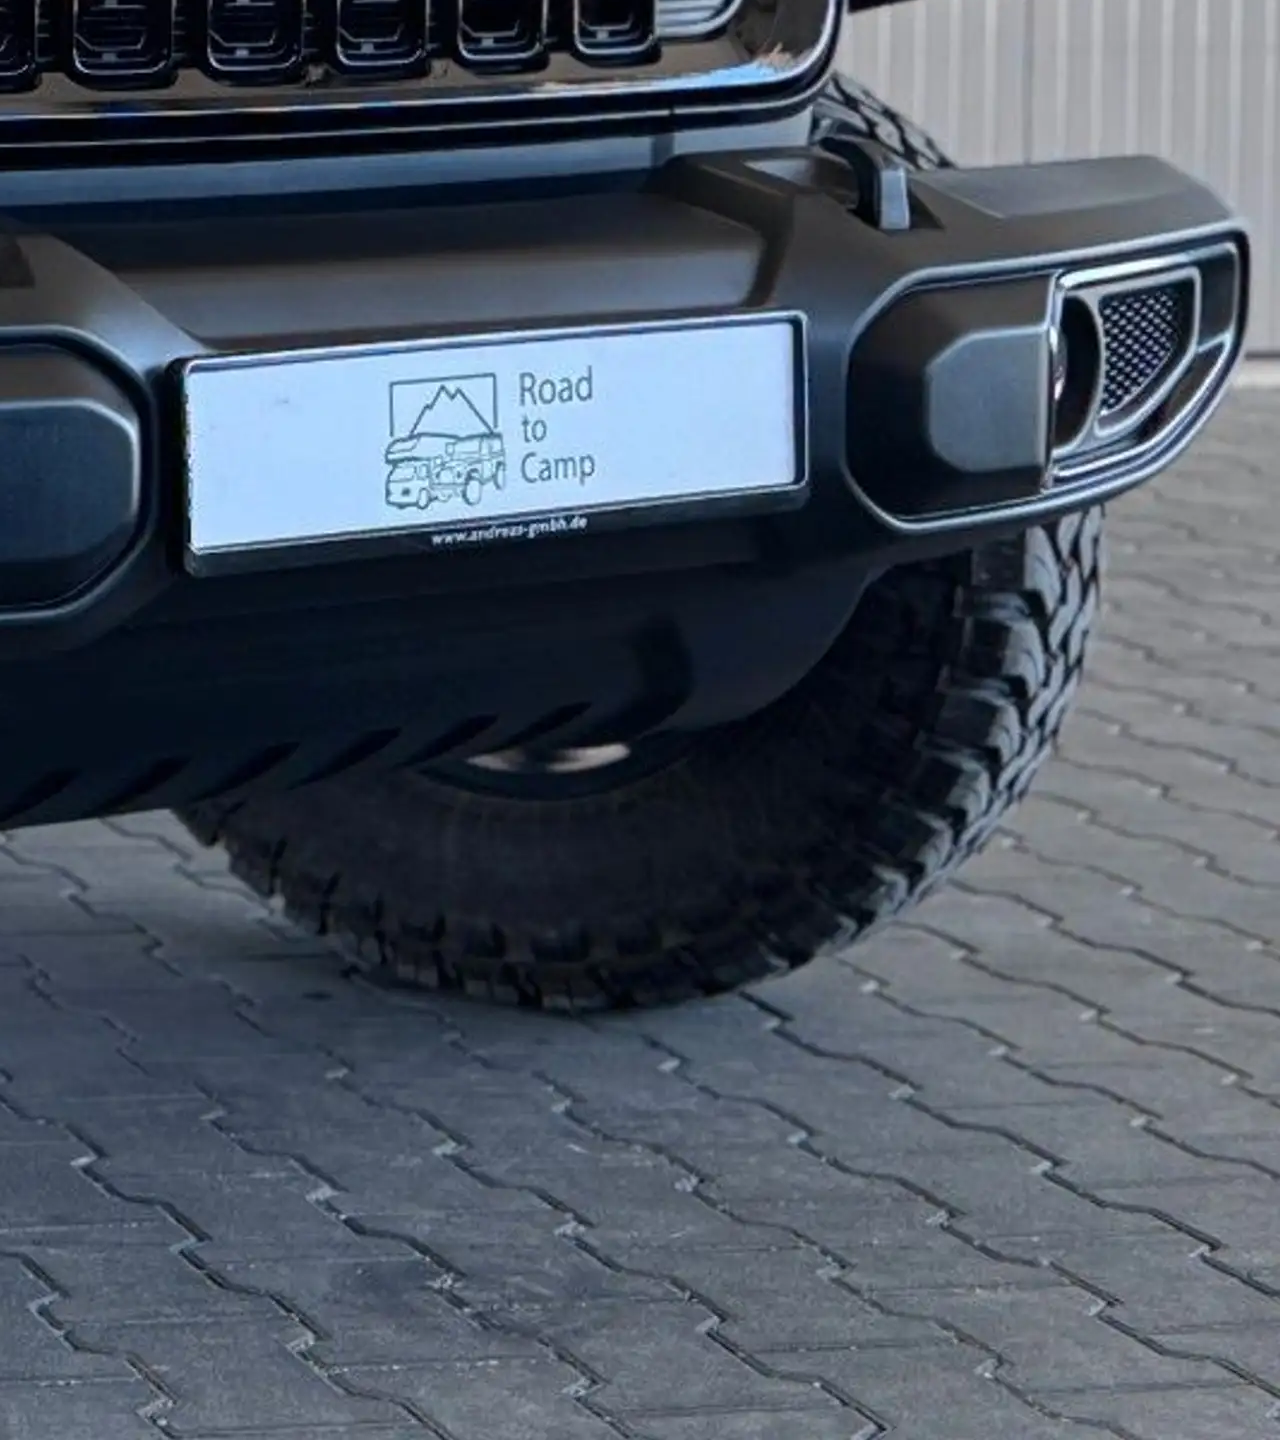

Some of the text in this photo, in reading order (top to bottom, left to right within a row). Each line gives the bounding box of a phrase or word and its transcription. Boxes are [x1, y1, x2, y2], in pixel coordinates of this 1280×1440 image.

[518, 364, 594, 407] Road
[521, 414, 548, 444] to
[520, 452, 595, 486] Camp
[431, 516, 587, 545] www.andreas-gmbh.de
